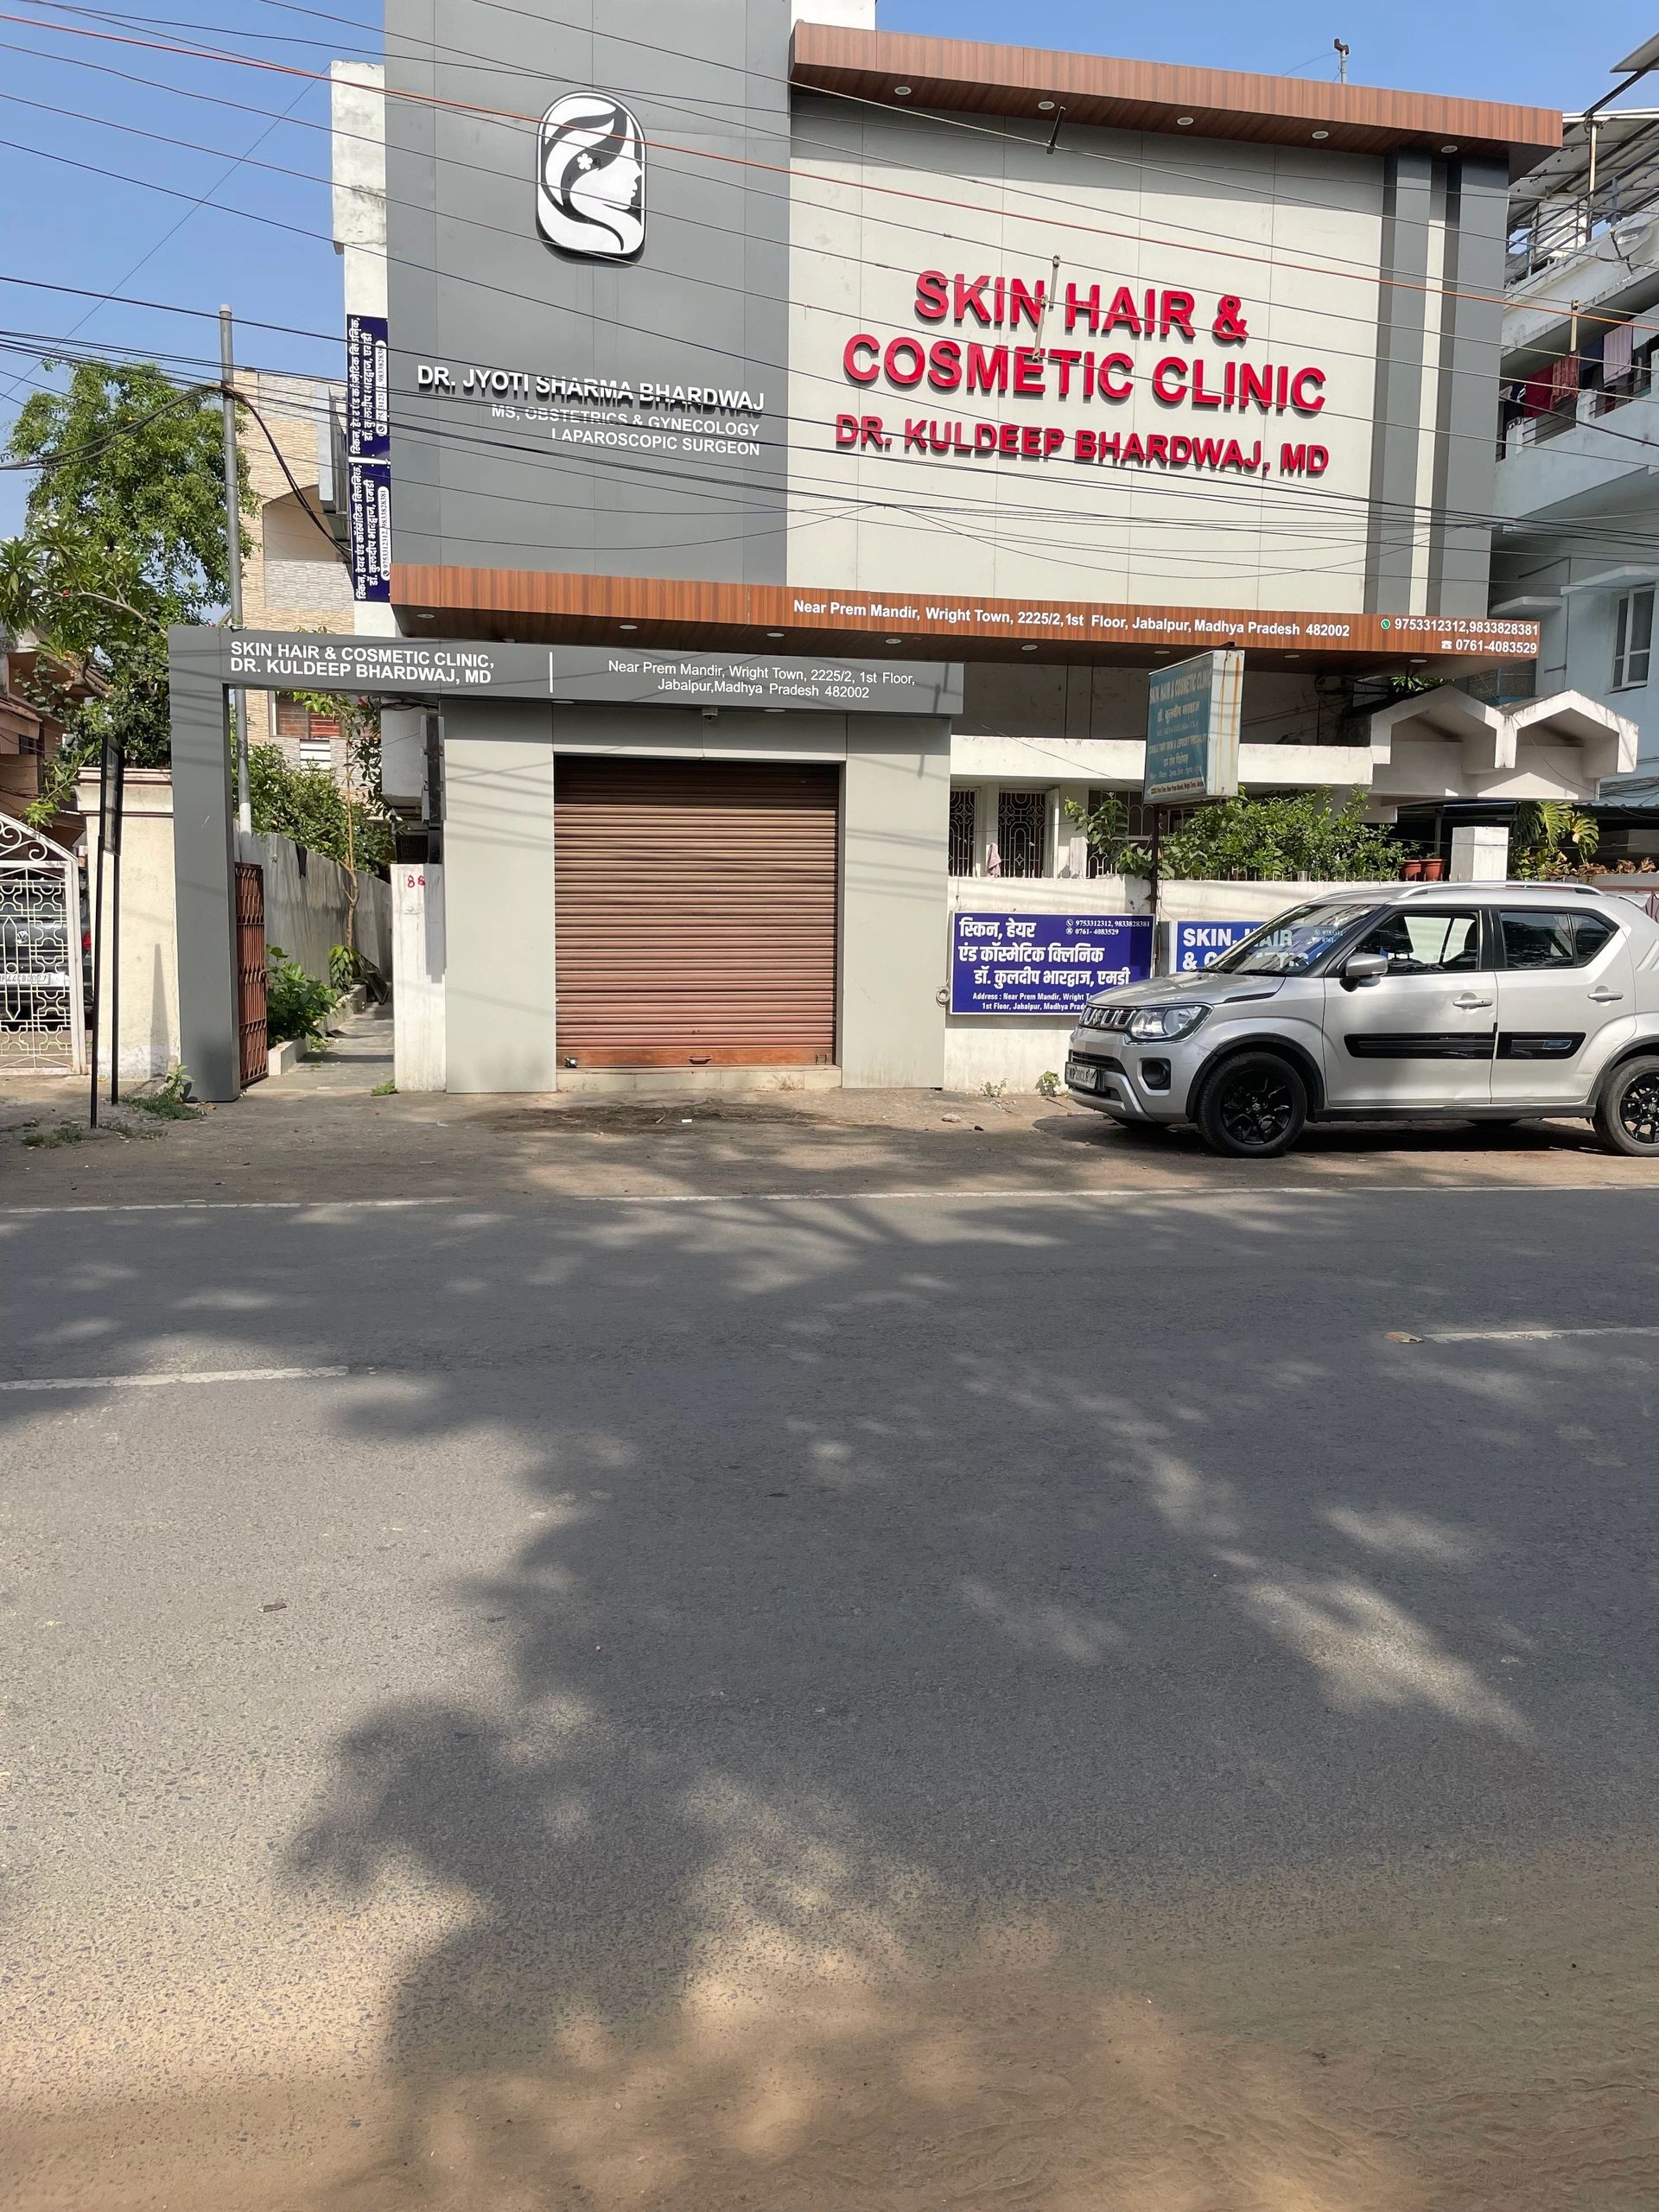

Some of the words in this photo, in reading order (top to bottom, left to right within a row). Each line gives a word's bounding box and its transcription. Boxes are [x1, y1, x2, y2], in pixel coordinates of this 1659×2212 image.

[914, 270, 1045, 326] SKIN
[1065, 282, 1196, 339] HAIR
[1214, 294, 1249, 343] &
[842, 333, 1133, 399] COSMETIC
[1152, 355, 1327, 413] CLINIC
[417, 365, 455, 387] DR.
[462, 367, 529, 391] JYOTI
[536, 376, 633, 402] SHARMA
[639, 382, 765, 410] BHARDWAJ
[492, 404, 520, 422] MS,
[649, 416, 760, 437] GYNECOLOGY
[551, 428, 677, 450] LAPAROSCOPIC
[682, 437, 760, 456] SURGEON
[836, 413, 891, 445] DR.
[904, 417, 1065, 457] KULDEEP
[1074, 429, 1270, 474] BHARDWAJ,
[1280, 442, 1330, 473] MD
[793, 599, 827, 613] Near
[830, 601, 866, 616] Prem
[870, 604, 920, 620] Mandir,
[925, 607, 970, 623] Wright
[975, 608, 1014, 625] Town,
[1091, 614, 1128, 631] Floor,
[1132, 616, 1192, 634] Jabalpur,
[1194, 619, 1244, 635] Madhya
[1248, 620, 1300, 636] Pradesh
[1306, 623, 1350, 638] 482002
[231, 641, 272, 657] SKIN
[277, 643, 320, 659] HAIR
[324, 646, 337, 660] &
[341, 646, 430, 664] COSMETIC
[435, 652, 495, 670] CLINIC,
[1455, 639, 1537, 654] 0761-4083529
[231, 658, 261, 673] DR.
[267, 659, 351, 677] KULDEEP
[356, 663, 461, 684] BHARDWAJ,
[465, 669, 492, 683] MD
[608, 659, 639, 673] Near
[643, 662, 677, 676] Prem
[680, 663, 726, 677] Mandir,
[728, 664, 768, 681] Wright
[772, 667, 807, 683] Town,
[810, 669, 855, 684] 2225/2,
[859, 671, 877, 683] 1st
[882, 671, 916, 687] Floor,
[769, 683, 819, 697] Pradesh
[825, 685, 869, 698] 482002
[959, 917, 1002, 940] स्किन,
[1006, 918, 1037, 938] हेयर
[958, 942, 978, 962] एंड
[980, 942, 1046, 963] कॉस्मेटिक
[1047, 943, 1105, 963] क्लिनिक
[1182, 951, 1198, 969] &
[974, 965, 991, 985] डॉ.
[995, 966, 1040, 988] कुलदीप
[1043, 969, 1095, 988] भारद्वाज,
[1097, 967, 1131, 985] एमडी
[972, 992, 998, 1001] Address
[1003, 993, 1018, 1001] Near
[1019, 993, 1036, 1001] Prem
[1037, 993, 1062, 1002] Mandir,
[1063, 993, 1084, 1003] Wright
[994, 1002, 1011, 1012] Floor,
[1013, 1003, 1042, 1012] Jabalpur,
[1043, 1003, 1068, 1012] Madhya
